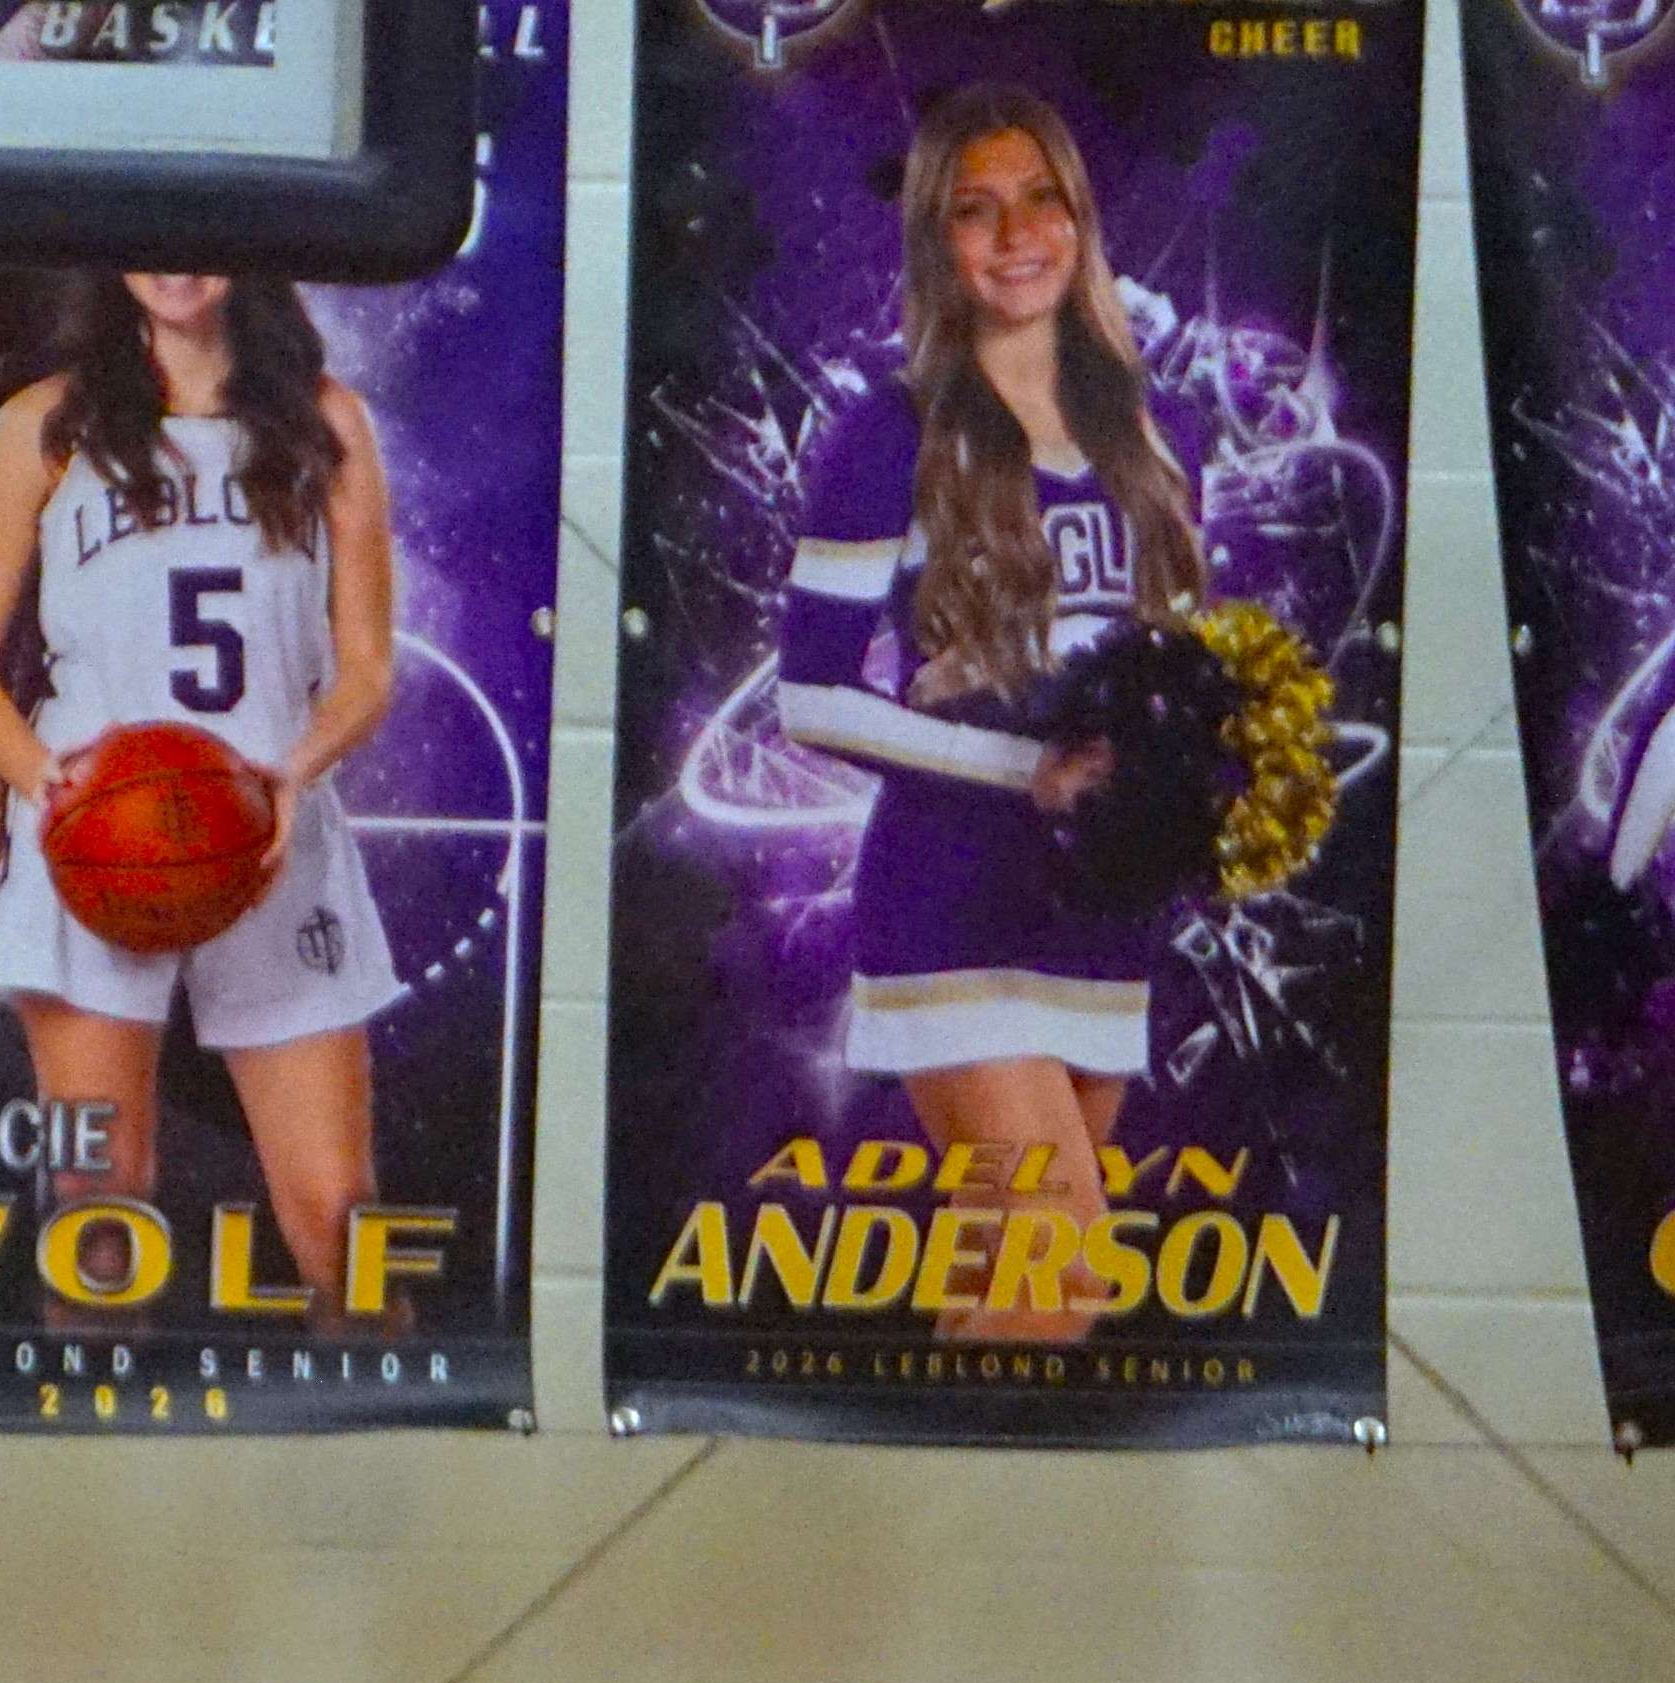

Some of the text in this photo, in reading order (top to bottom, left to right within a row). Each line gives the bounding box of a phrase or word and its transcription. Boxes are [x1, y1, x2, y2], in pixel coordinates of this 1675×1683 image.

[1209, 19, 1363, 60] CHEER
[168, 566, 245, 713] 5
[749, 1137, 1249, 1197] ADELYN
[649, 1200, 1341, 1320] ANDERSON
[199, 1347, 450, 1382] SENIOR
